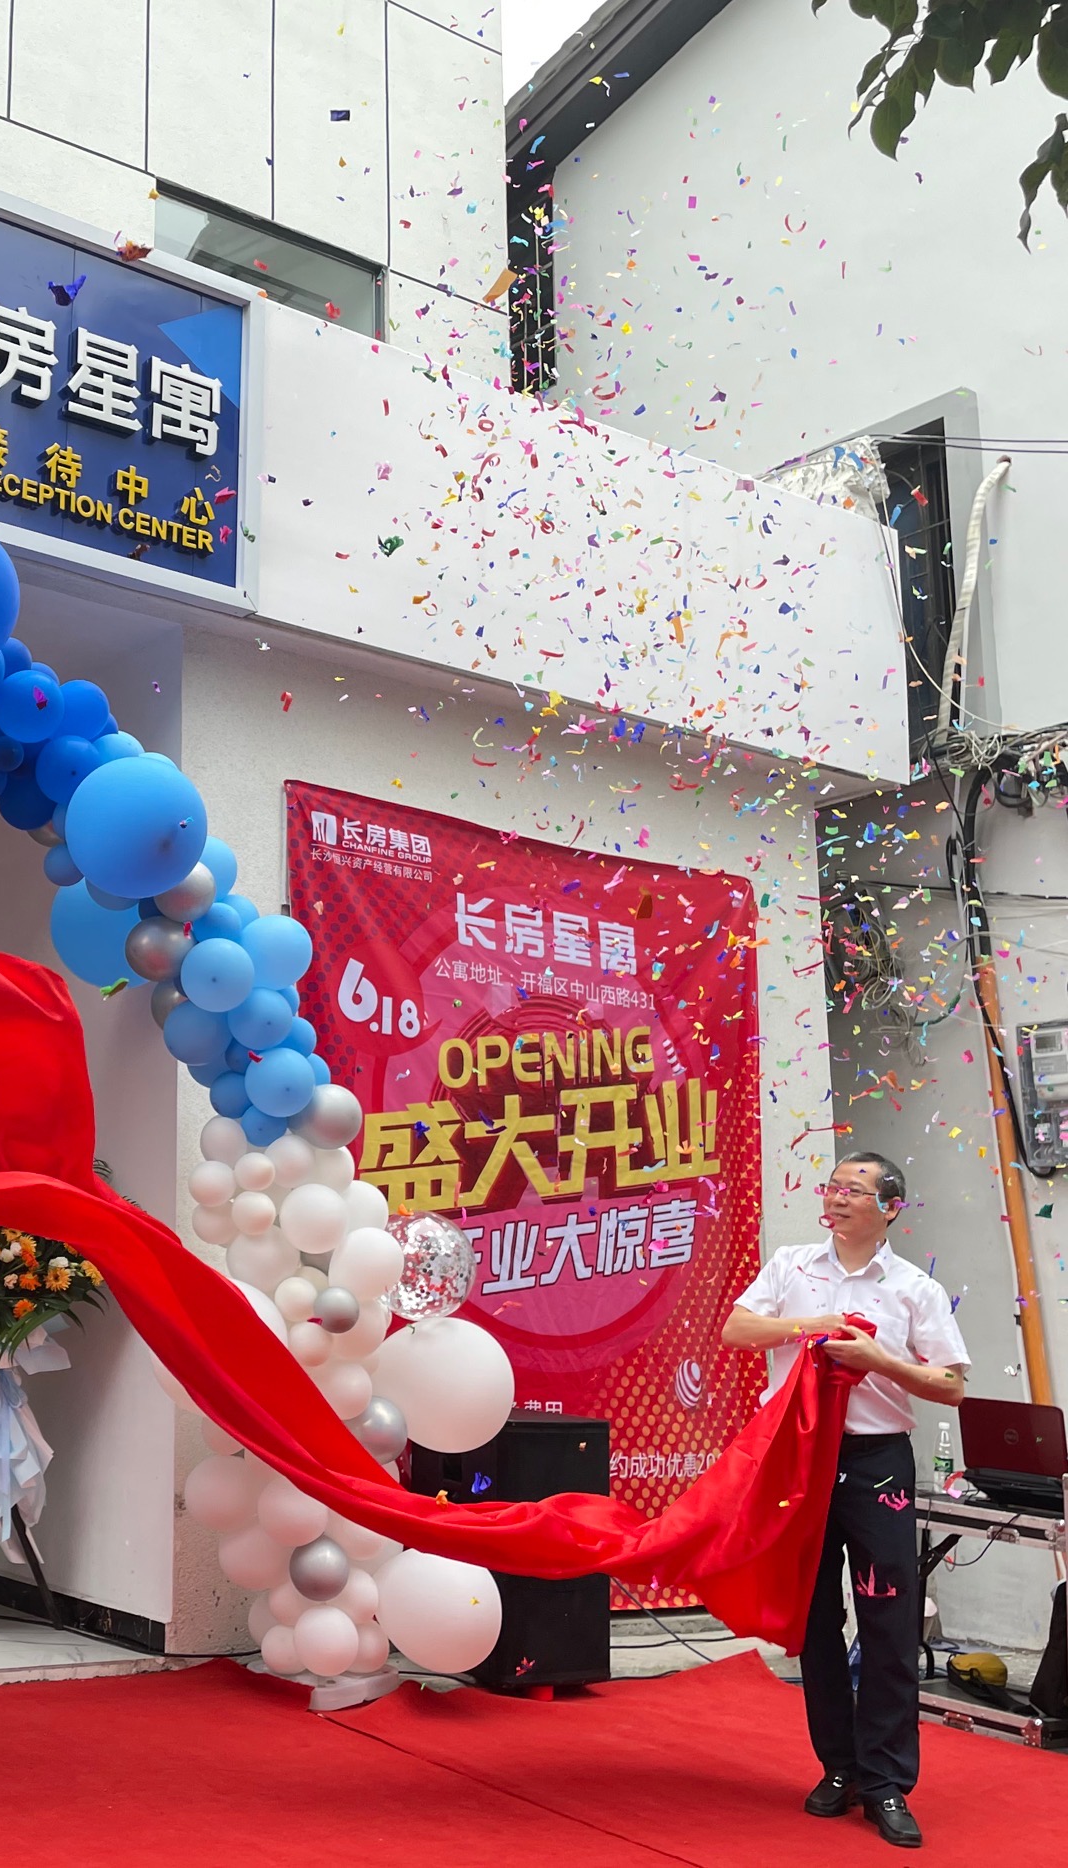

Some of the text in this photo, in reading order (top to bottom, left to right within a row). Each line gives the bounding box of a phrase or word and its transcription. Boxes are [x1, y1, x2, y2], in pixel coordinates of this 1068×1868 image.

[117, 508, 215, 554] CENTER
[341, 817, 432, 857] 长房集团
[342, 841, 432, 864] CHANFINE GROUP
[454, 892, 637, 976] 长房星寓
[337, 957, 421, 1039] 6.18
[438, 1026, 655, 1089] OPENING
[358, 1078, 721, 1214] 盛大开业
[609, 1451, 722, 1479] 约成功优惠20
